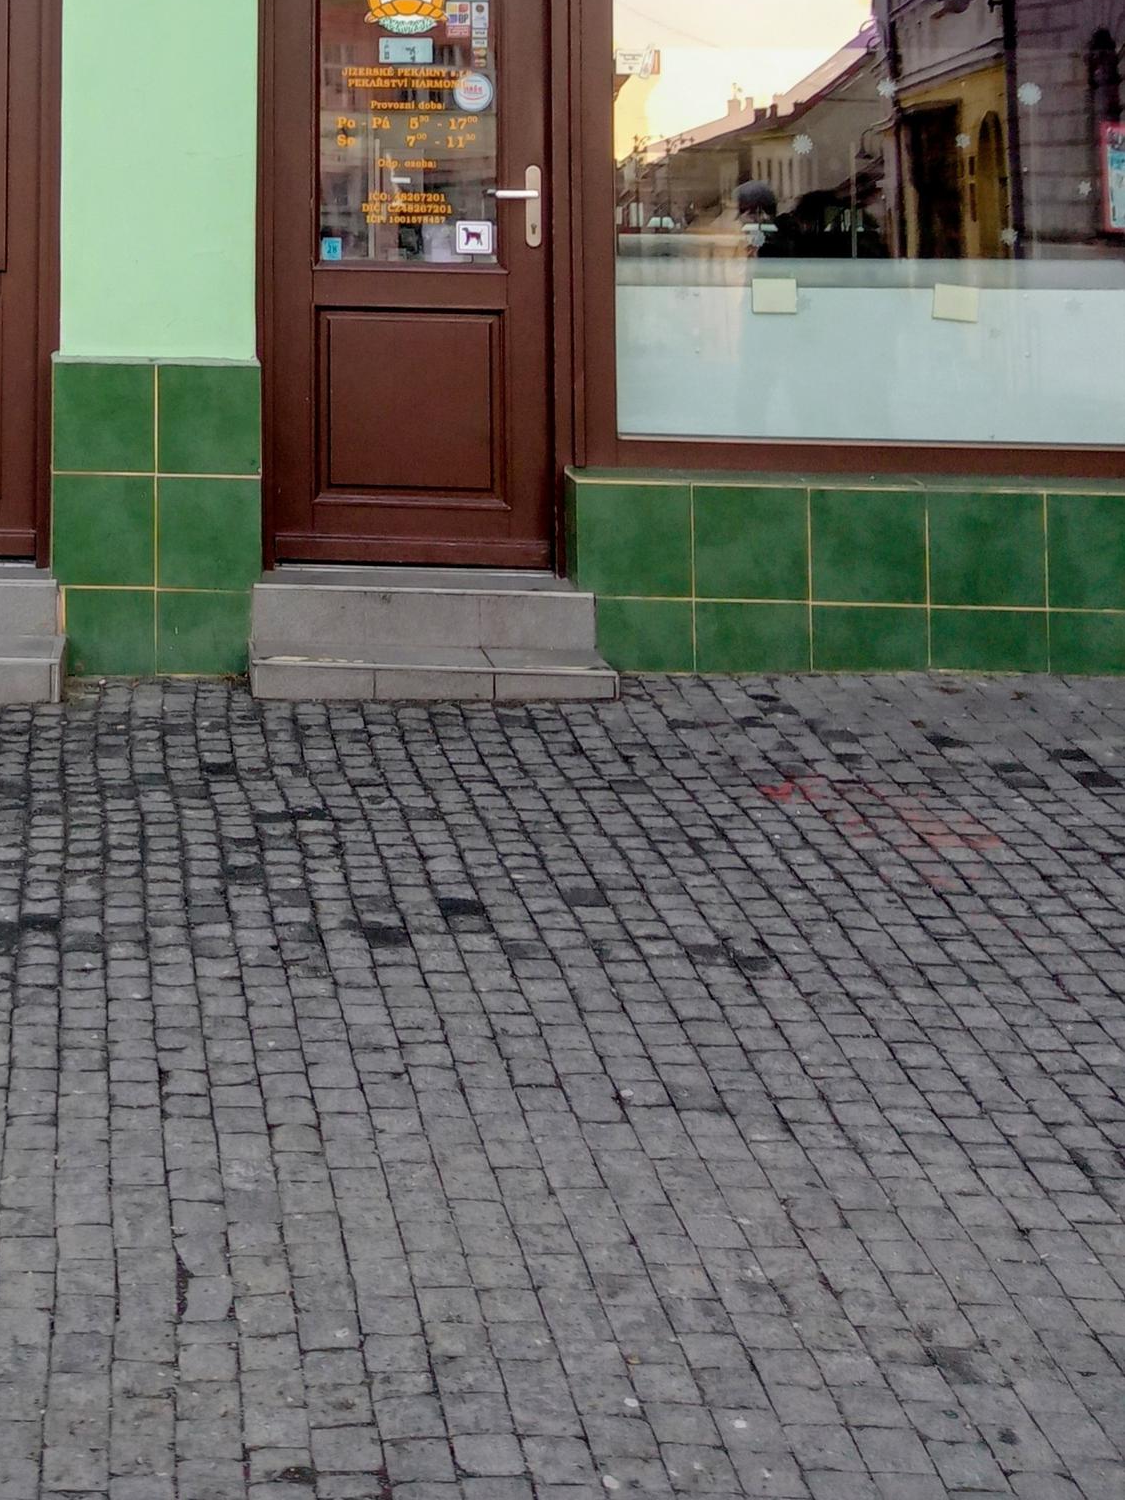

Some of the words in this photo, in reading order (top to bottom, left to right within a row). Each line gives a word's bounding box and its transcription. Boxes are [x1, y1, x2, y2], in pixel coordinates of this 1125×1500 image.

[341, 66, 395, 78] JIZERSKÉ
[336, 115, 356, 130] Po
[371, 115, 391, 130] Pá
